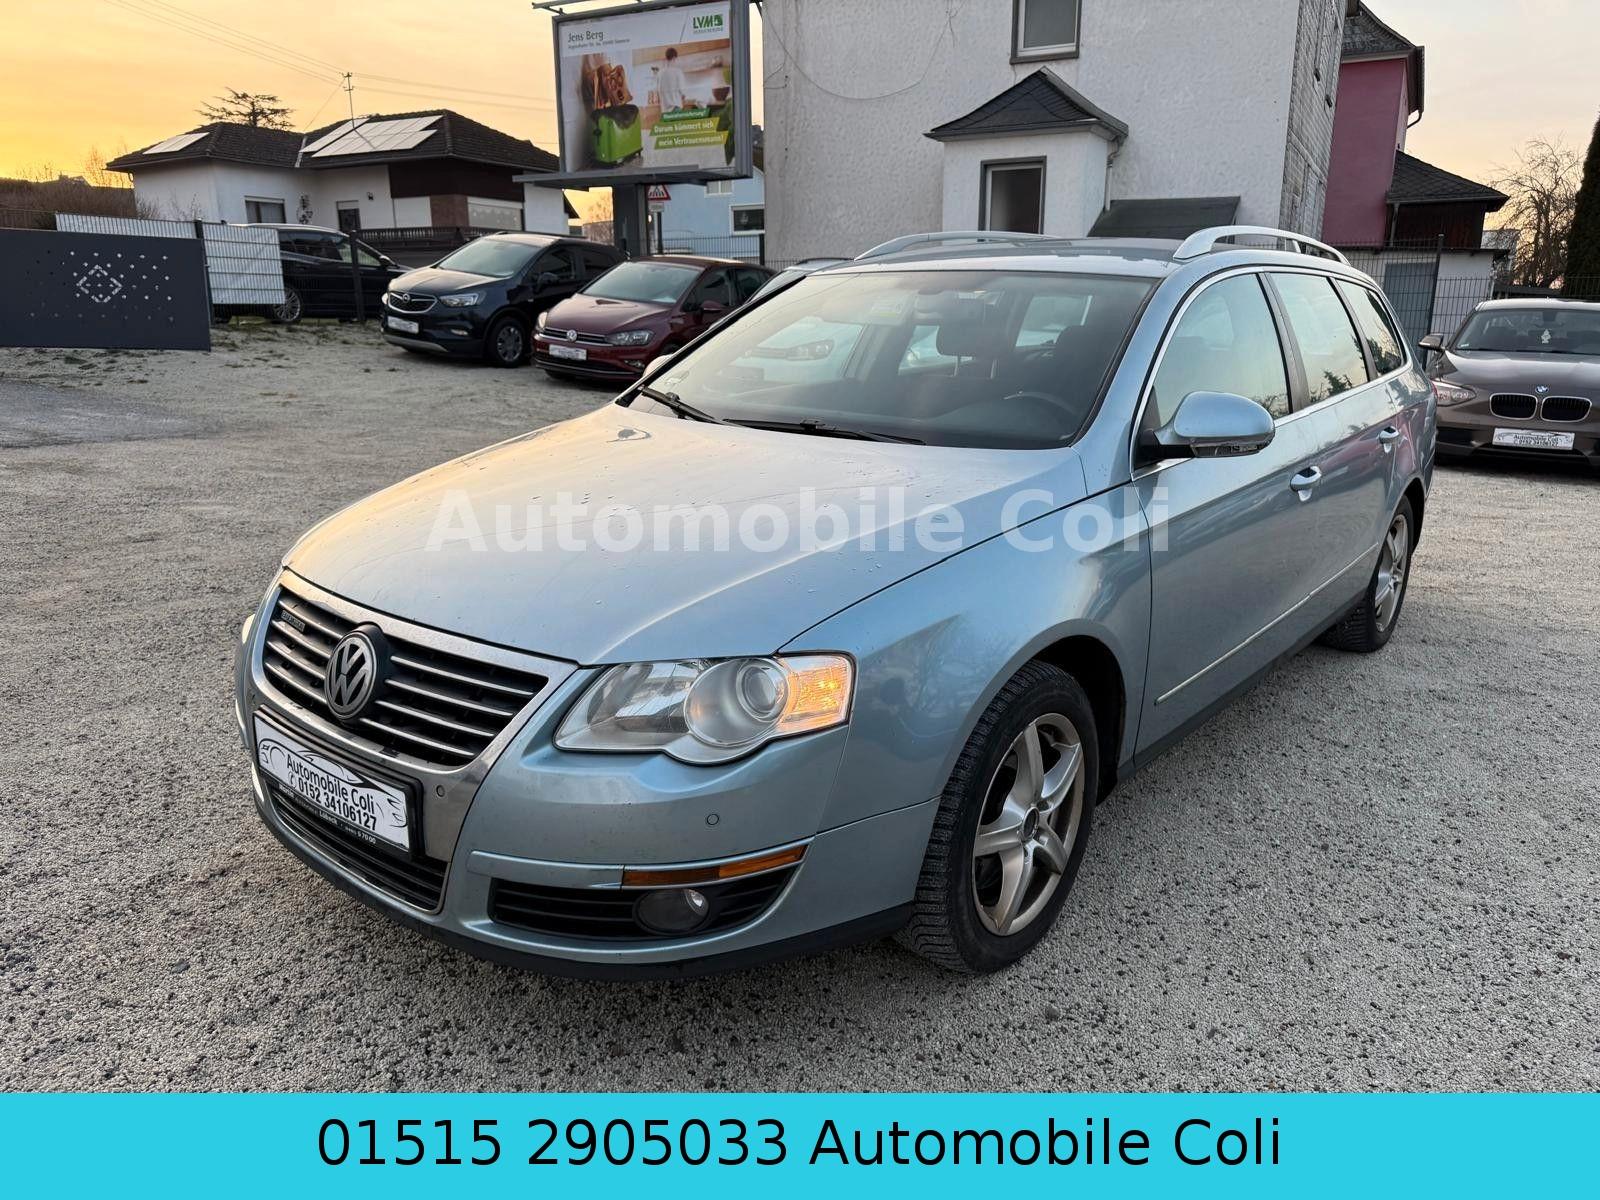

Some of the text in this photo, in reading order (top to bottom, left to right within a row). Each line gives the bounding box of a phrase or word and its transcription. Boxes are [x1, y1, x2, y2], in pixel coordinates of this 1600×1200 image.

[567, 30, 604, 43] Jens Berg
[693, 15, 713, 29] LVM
[286, 754, 349, 803] Automobile
[351, 788, 375, 815] Coli
[298, 777, 322, 804] 0152
[323, 791, 377, 832] 34106127
